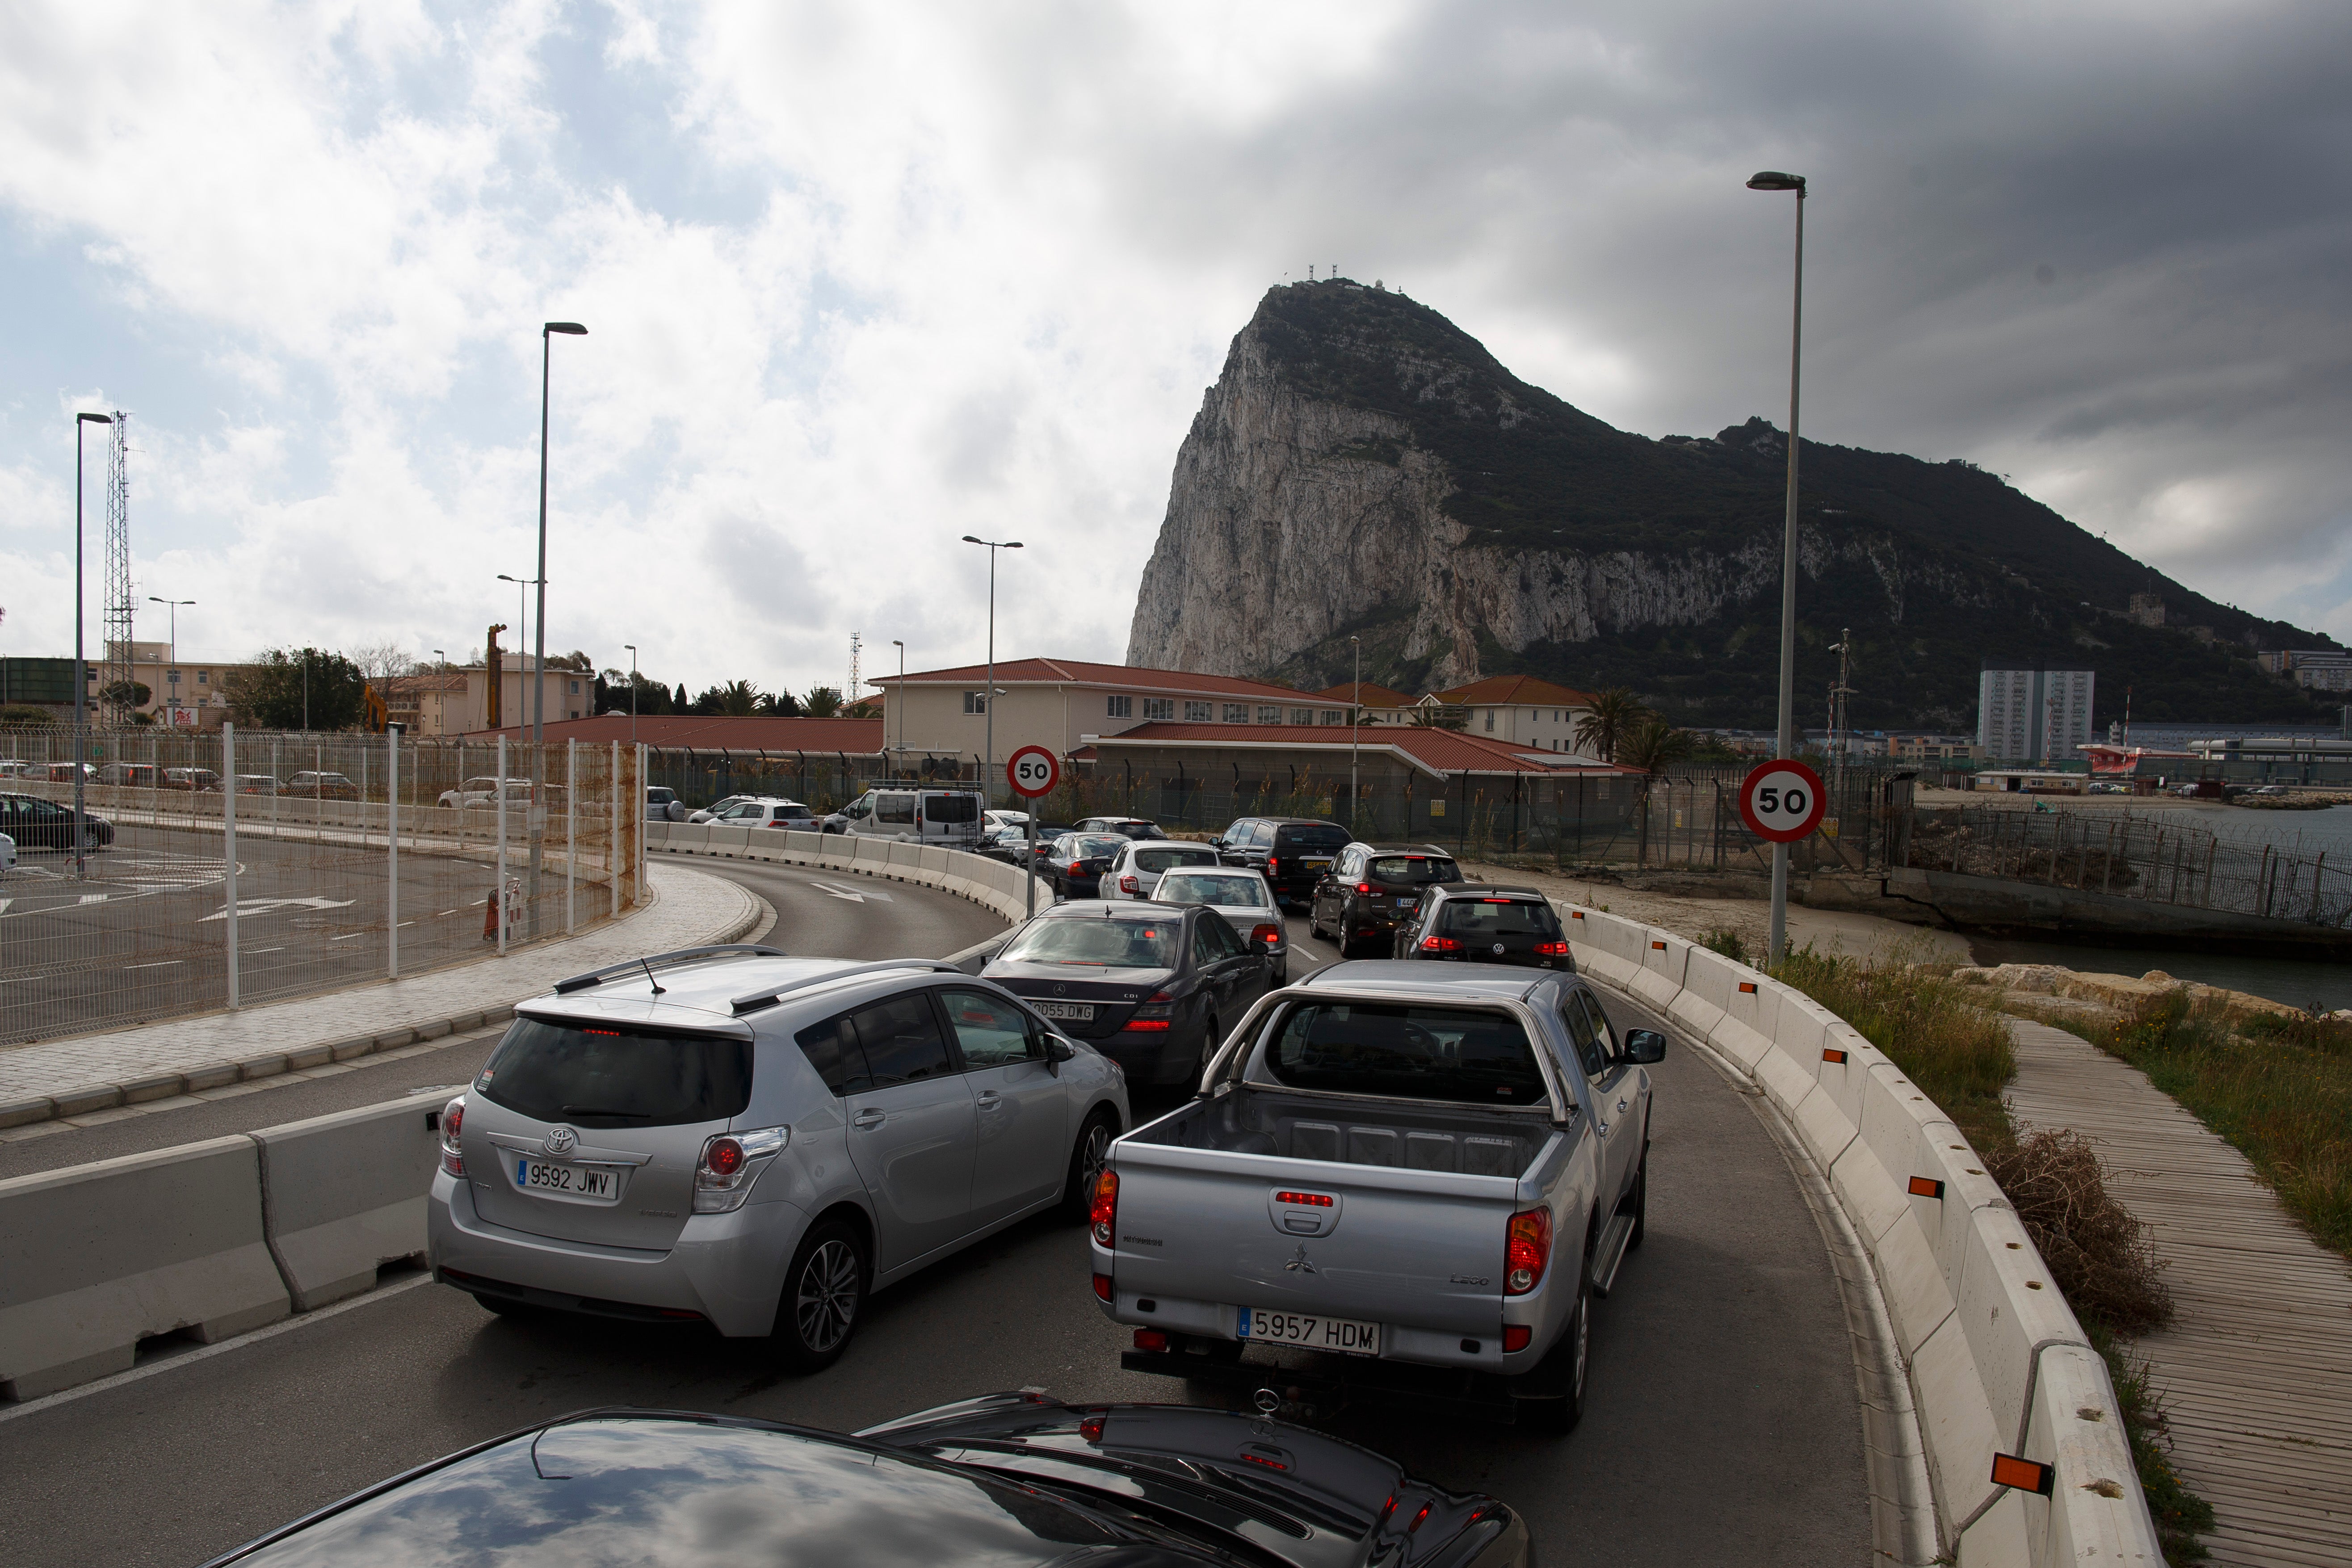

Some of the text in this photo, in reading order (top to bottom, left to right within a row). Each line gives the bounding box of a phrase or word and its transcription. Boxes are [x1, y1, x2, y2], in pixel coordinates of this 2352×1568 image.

[1019, 763, 1048, 779] 50
[1759, 788, 1806, 815] 50
[1034, 1004, 1091, 1018] 0055 DWG
[531, 1164, 571, 1190] 9592
[577, 1172, 609, 1194] JWV
[638, 1209, 677, 1218] VERSO
[1123, 1235, 1163, 1246] MITSUBISHI
[1450, 1273, 1489, 1286] L200
[1256, 1312, 1317, 1341] 5957
[1325, 1321, 1373, 1349] HDM
[1272, 1342, 1340, 1354] www.grupogallardo.com
